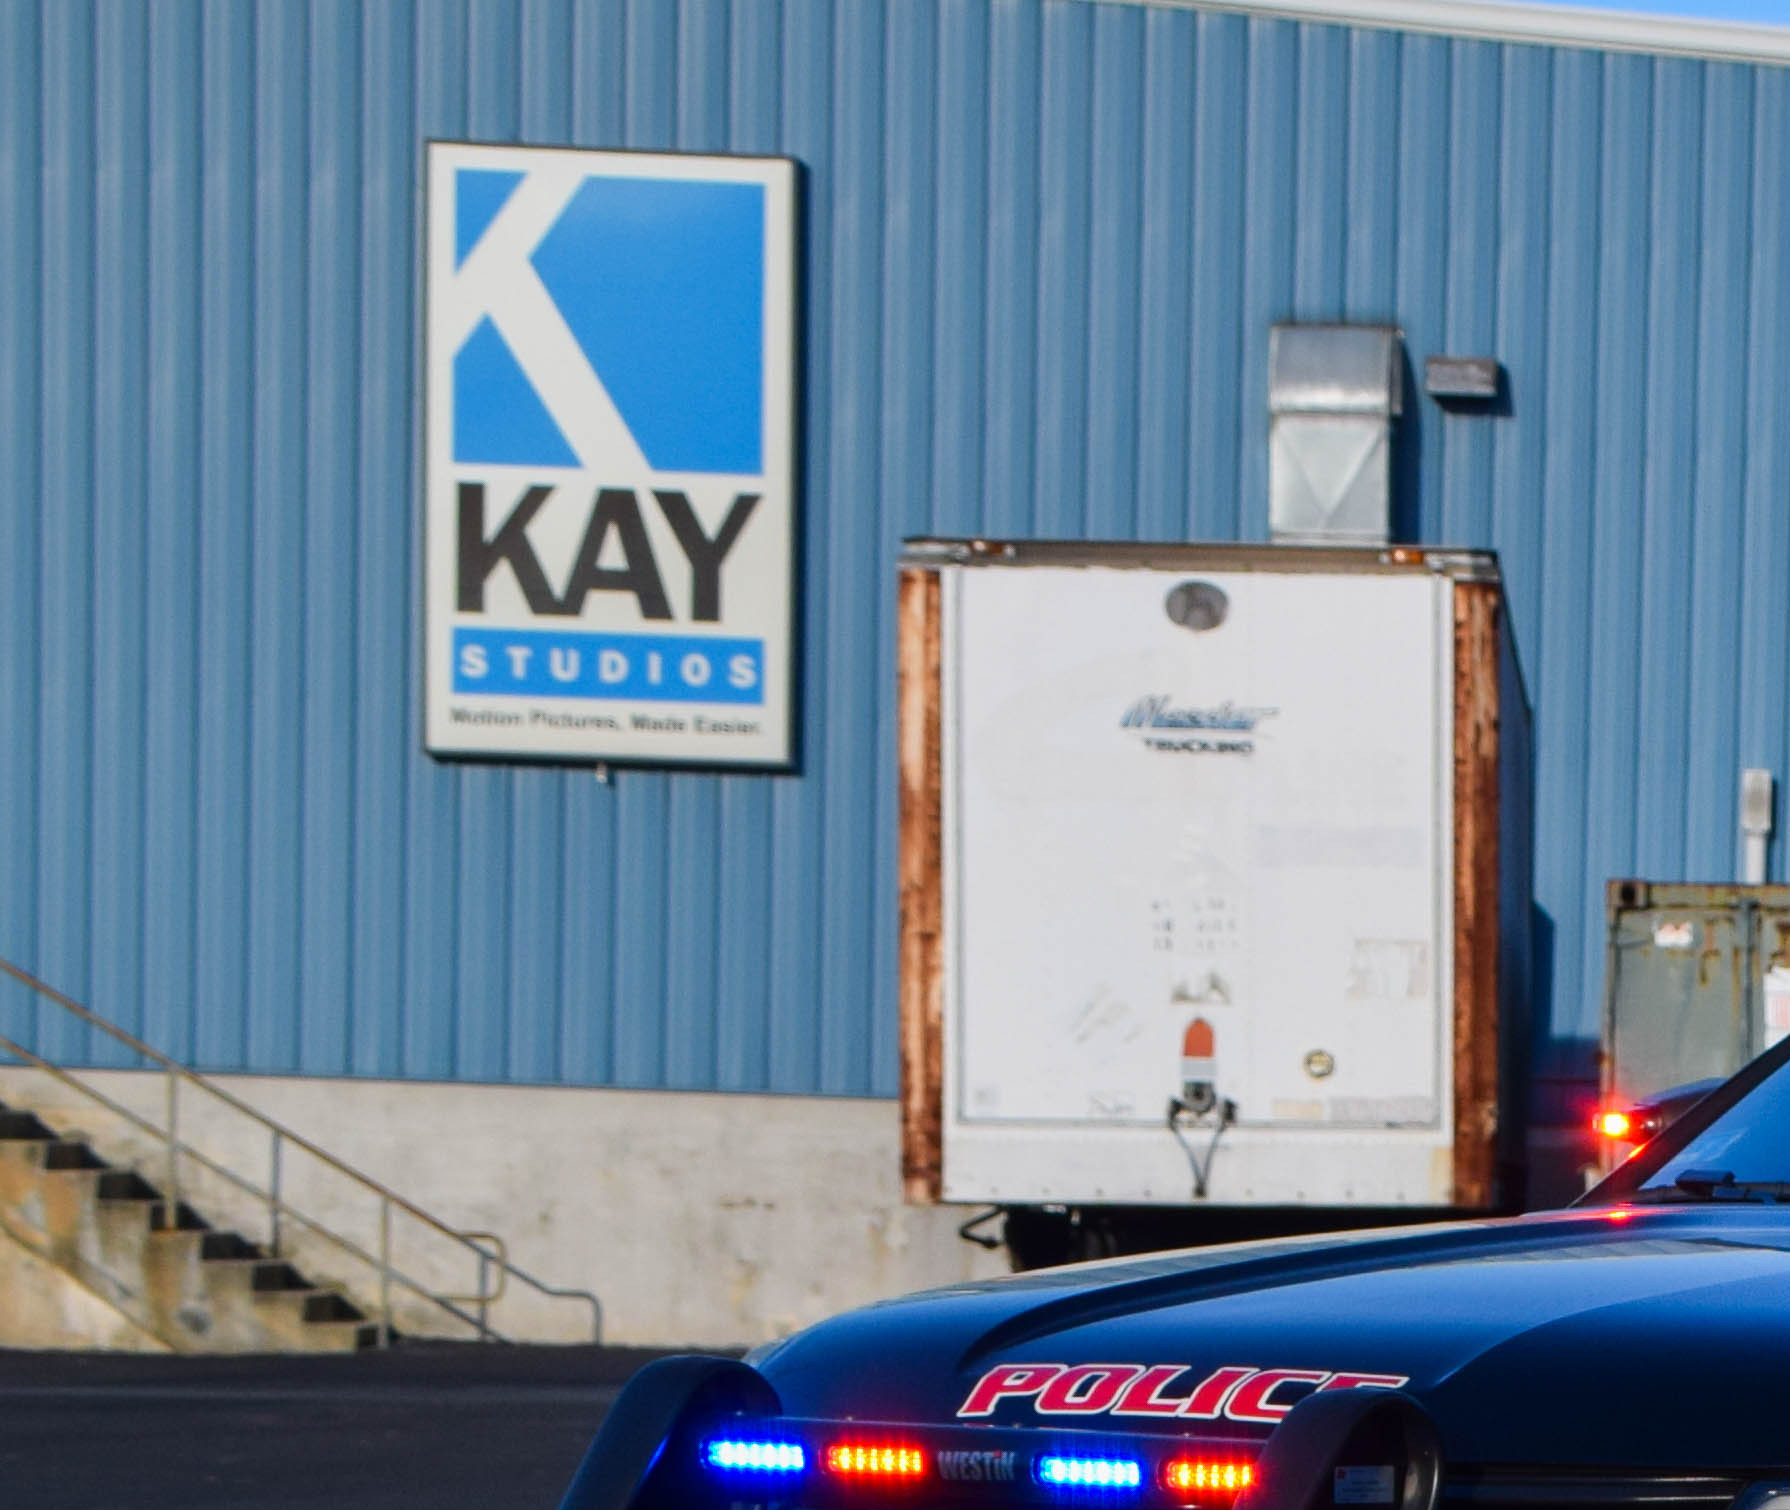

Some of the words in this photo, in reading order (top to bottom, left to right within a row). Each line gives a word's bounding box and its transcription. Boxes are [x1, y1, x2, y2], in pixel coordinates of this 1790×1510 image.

[455, 481, 764, 624] KAY
[461, 644, 757, 690] STUDIOS
[450, 706, 521, 727] Motion
[630, 711, 684, 733] Made
[957, 1363, 1409, 1424] POLIC
